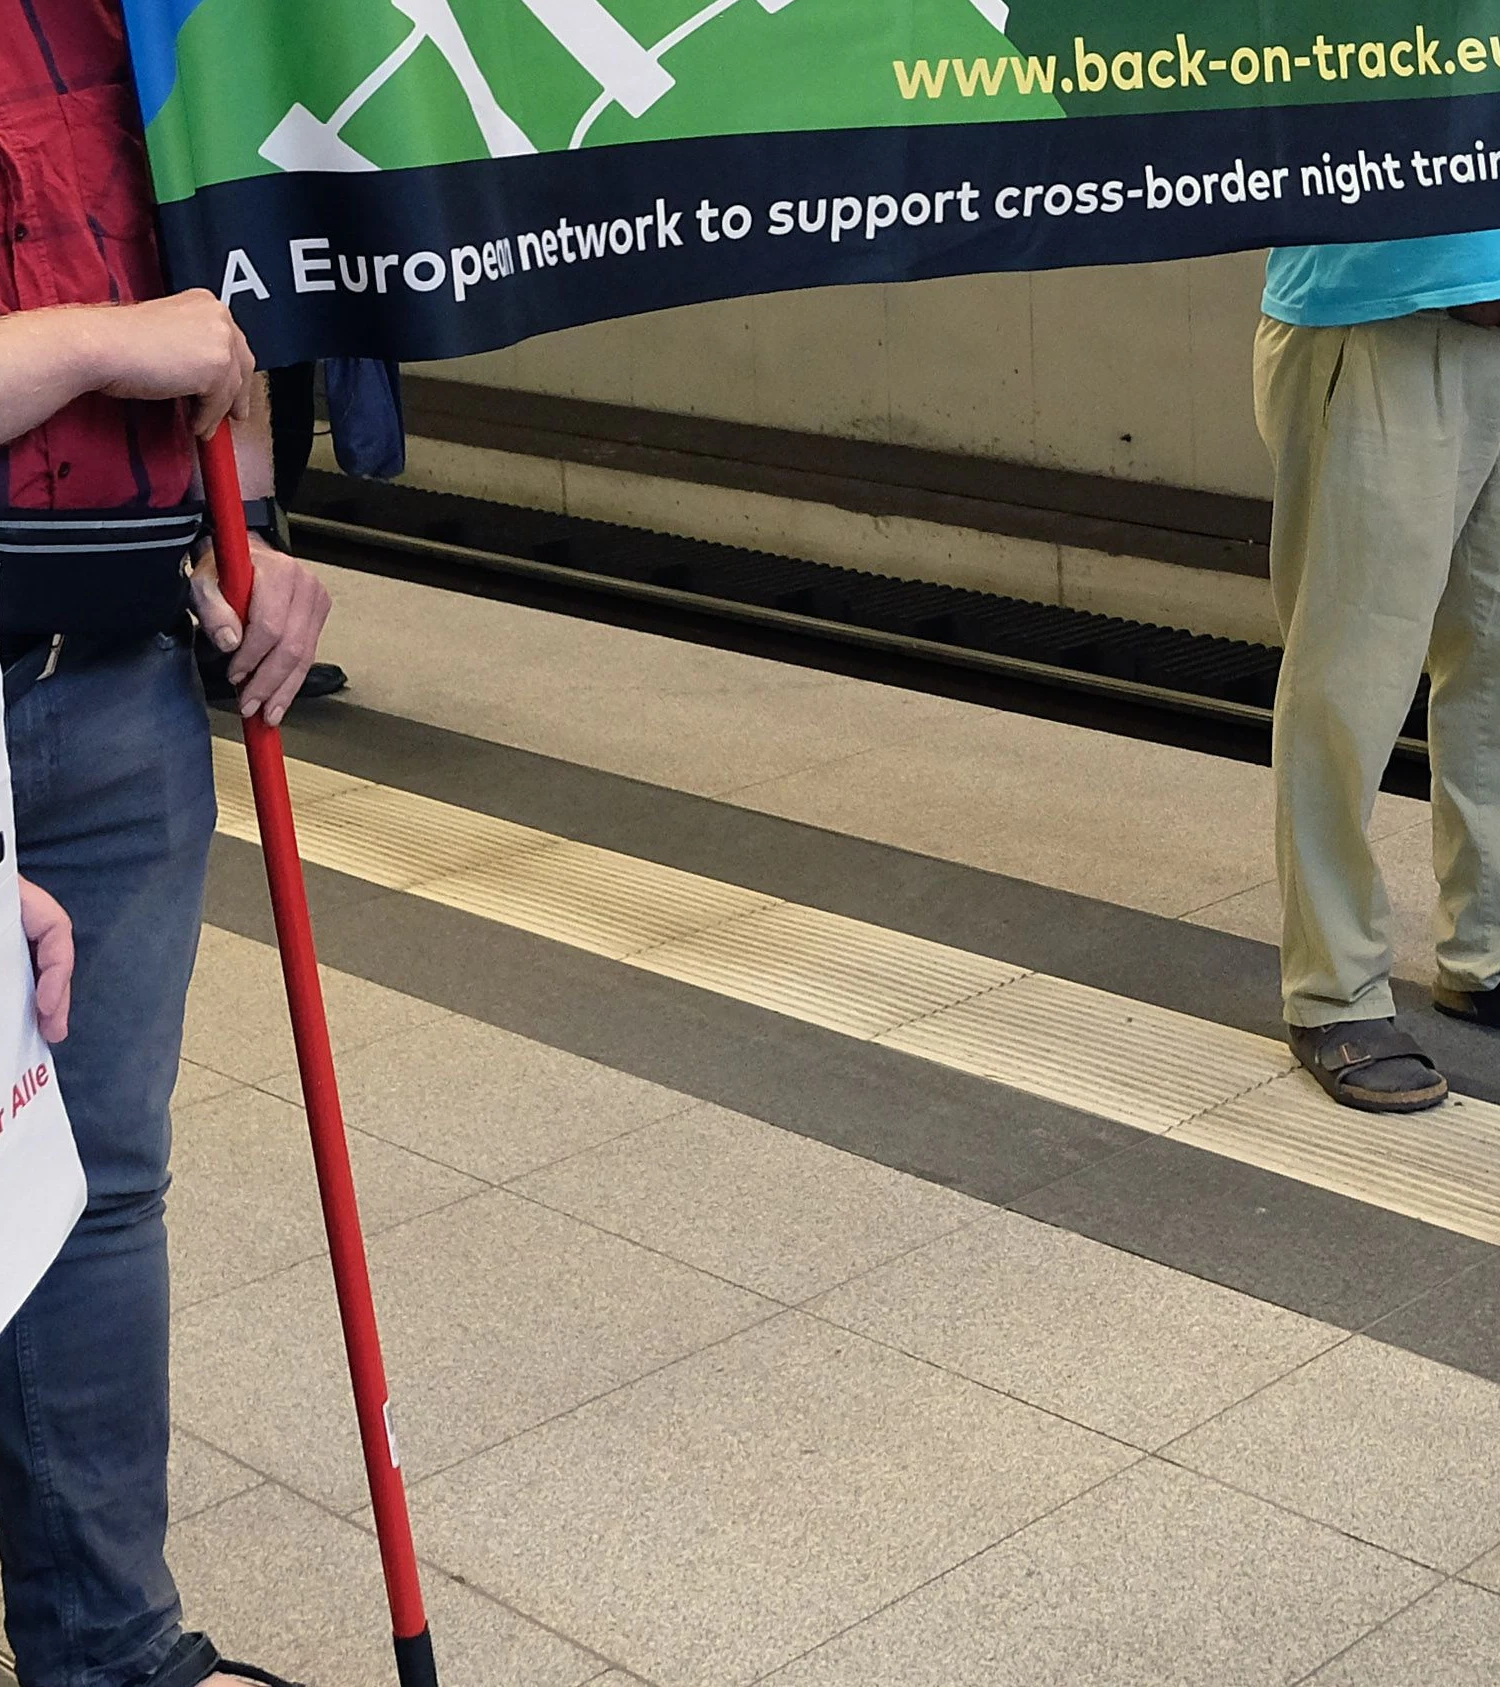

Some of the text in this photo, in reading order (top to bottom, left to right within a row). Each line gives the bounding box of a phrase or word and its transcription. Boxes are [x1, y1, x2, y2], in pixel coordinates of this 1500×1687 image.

[220, 249, 270, 305] A
[290, 238, 514, 302] European
[518, 198, 684, 272] network
[695, 201, 753, 243] to
[766, 177, 980, 239] support
[993, 157, 1289, 220] cross-border
[1300, 149, 1405, 206] night
[11, 1062, 49, 1119] Alle
